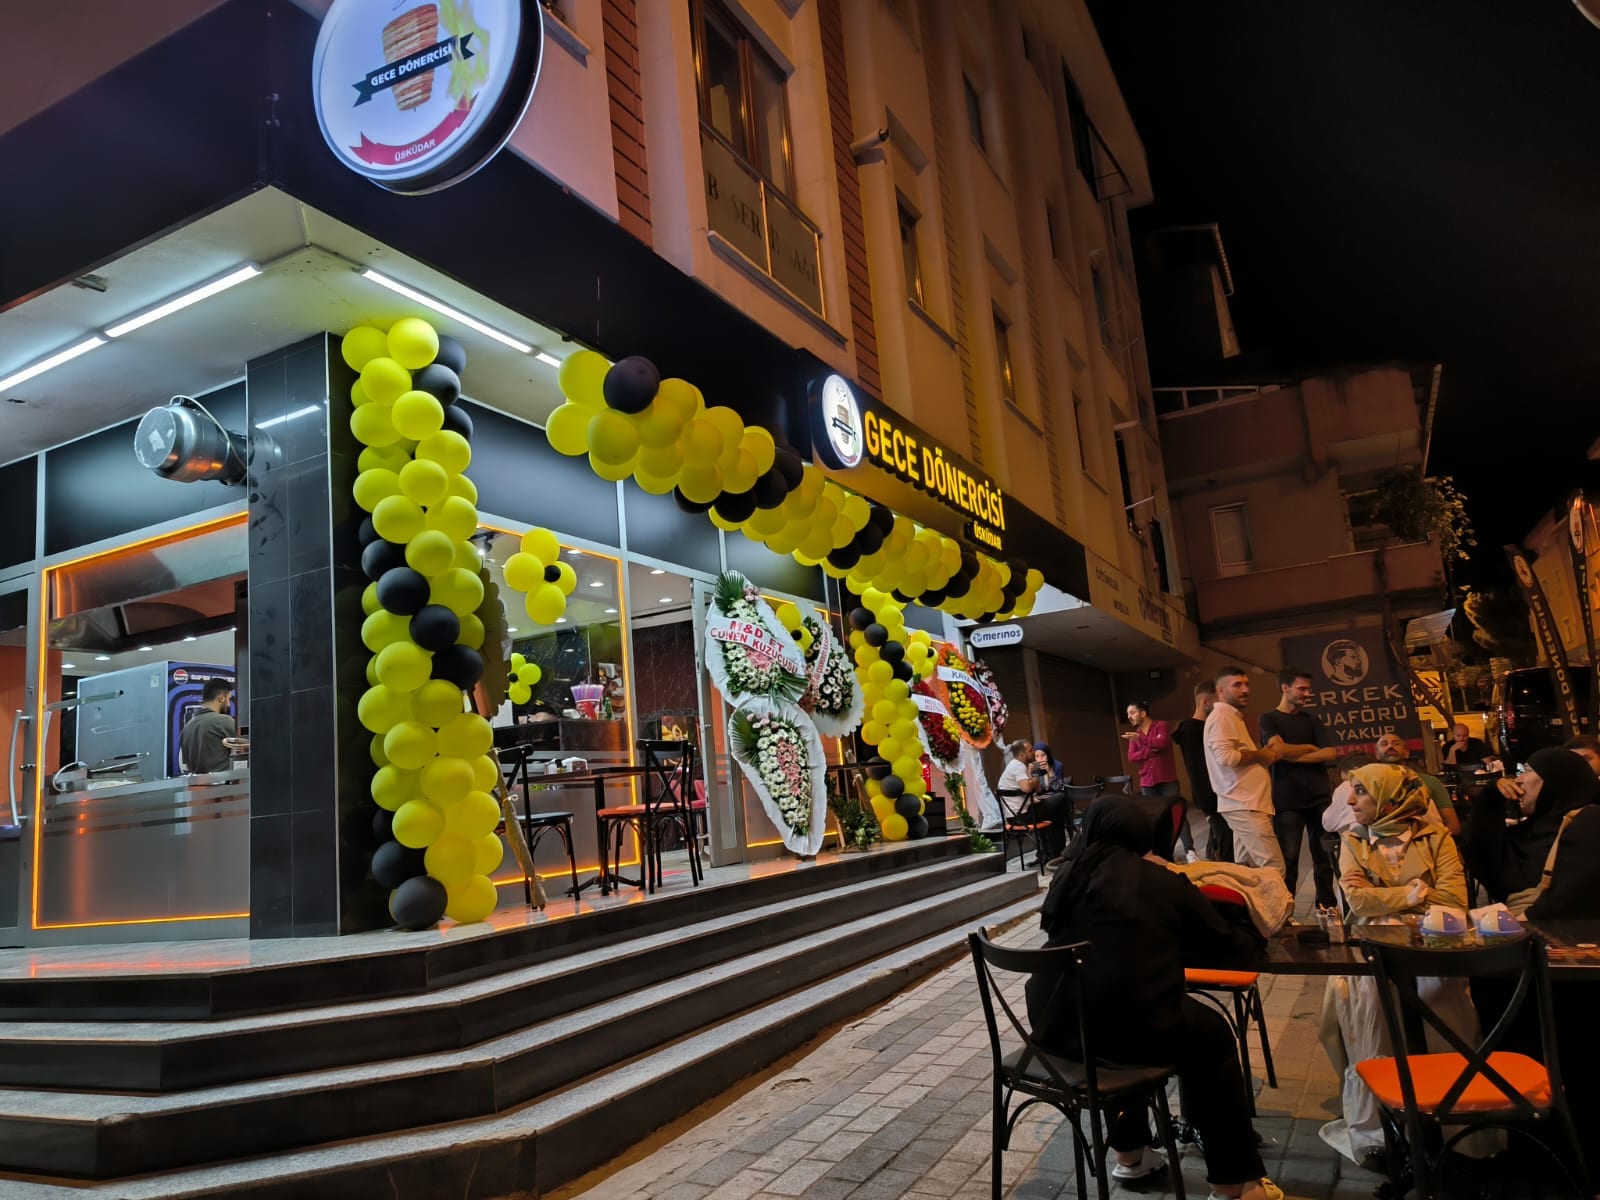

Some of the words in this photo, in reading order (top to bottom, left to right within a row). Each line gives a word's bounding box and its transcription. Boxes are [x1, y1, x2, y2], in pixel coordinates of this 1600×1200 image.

[371, 69, 396, 86] GECE
[394, 138, 437, 161] ÜSKÜDAR
[864, 410, 919, 481] GECE
[922, 446, 1006, 530] DÖNERCİSİ
[769, 638, 785, 652] ET
[1318, 701, 1408, 727] UAFÖRÜ
